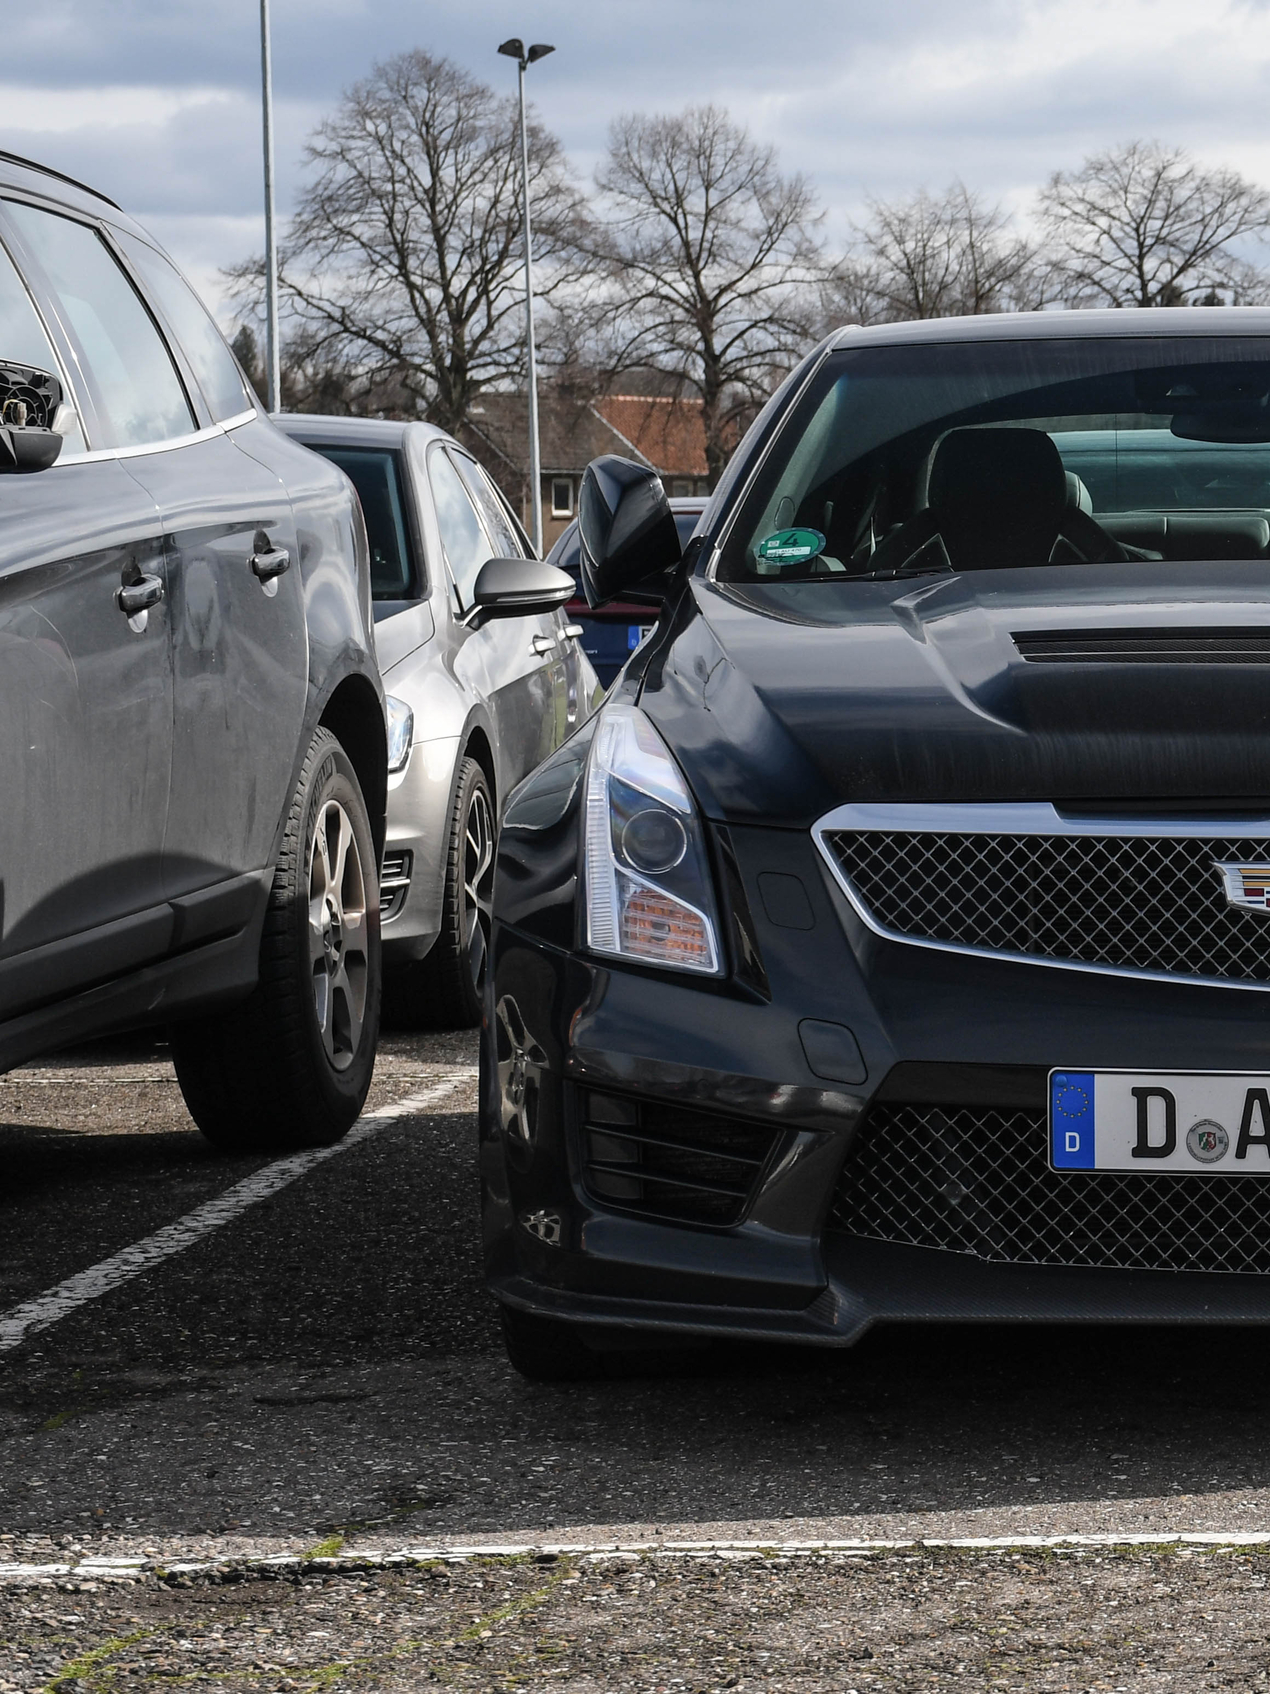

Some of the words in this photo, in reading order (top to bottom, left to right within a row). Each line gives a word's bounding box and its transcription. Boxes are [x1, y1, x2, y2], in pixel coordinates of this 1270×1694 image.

[782, 532, 799, 547] 4
[1131, 1086, 1177, 1159] D
[1065, 1131, 1081, 1152] D
